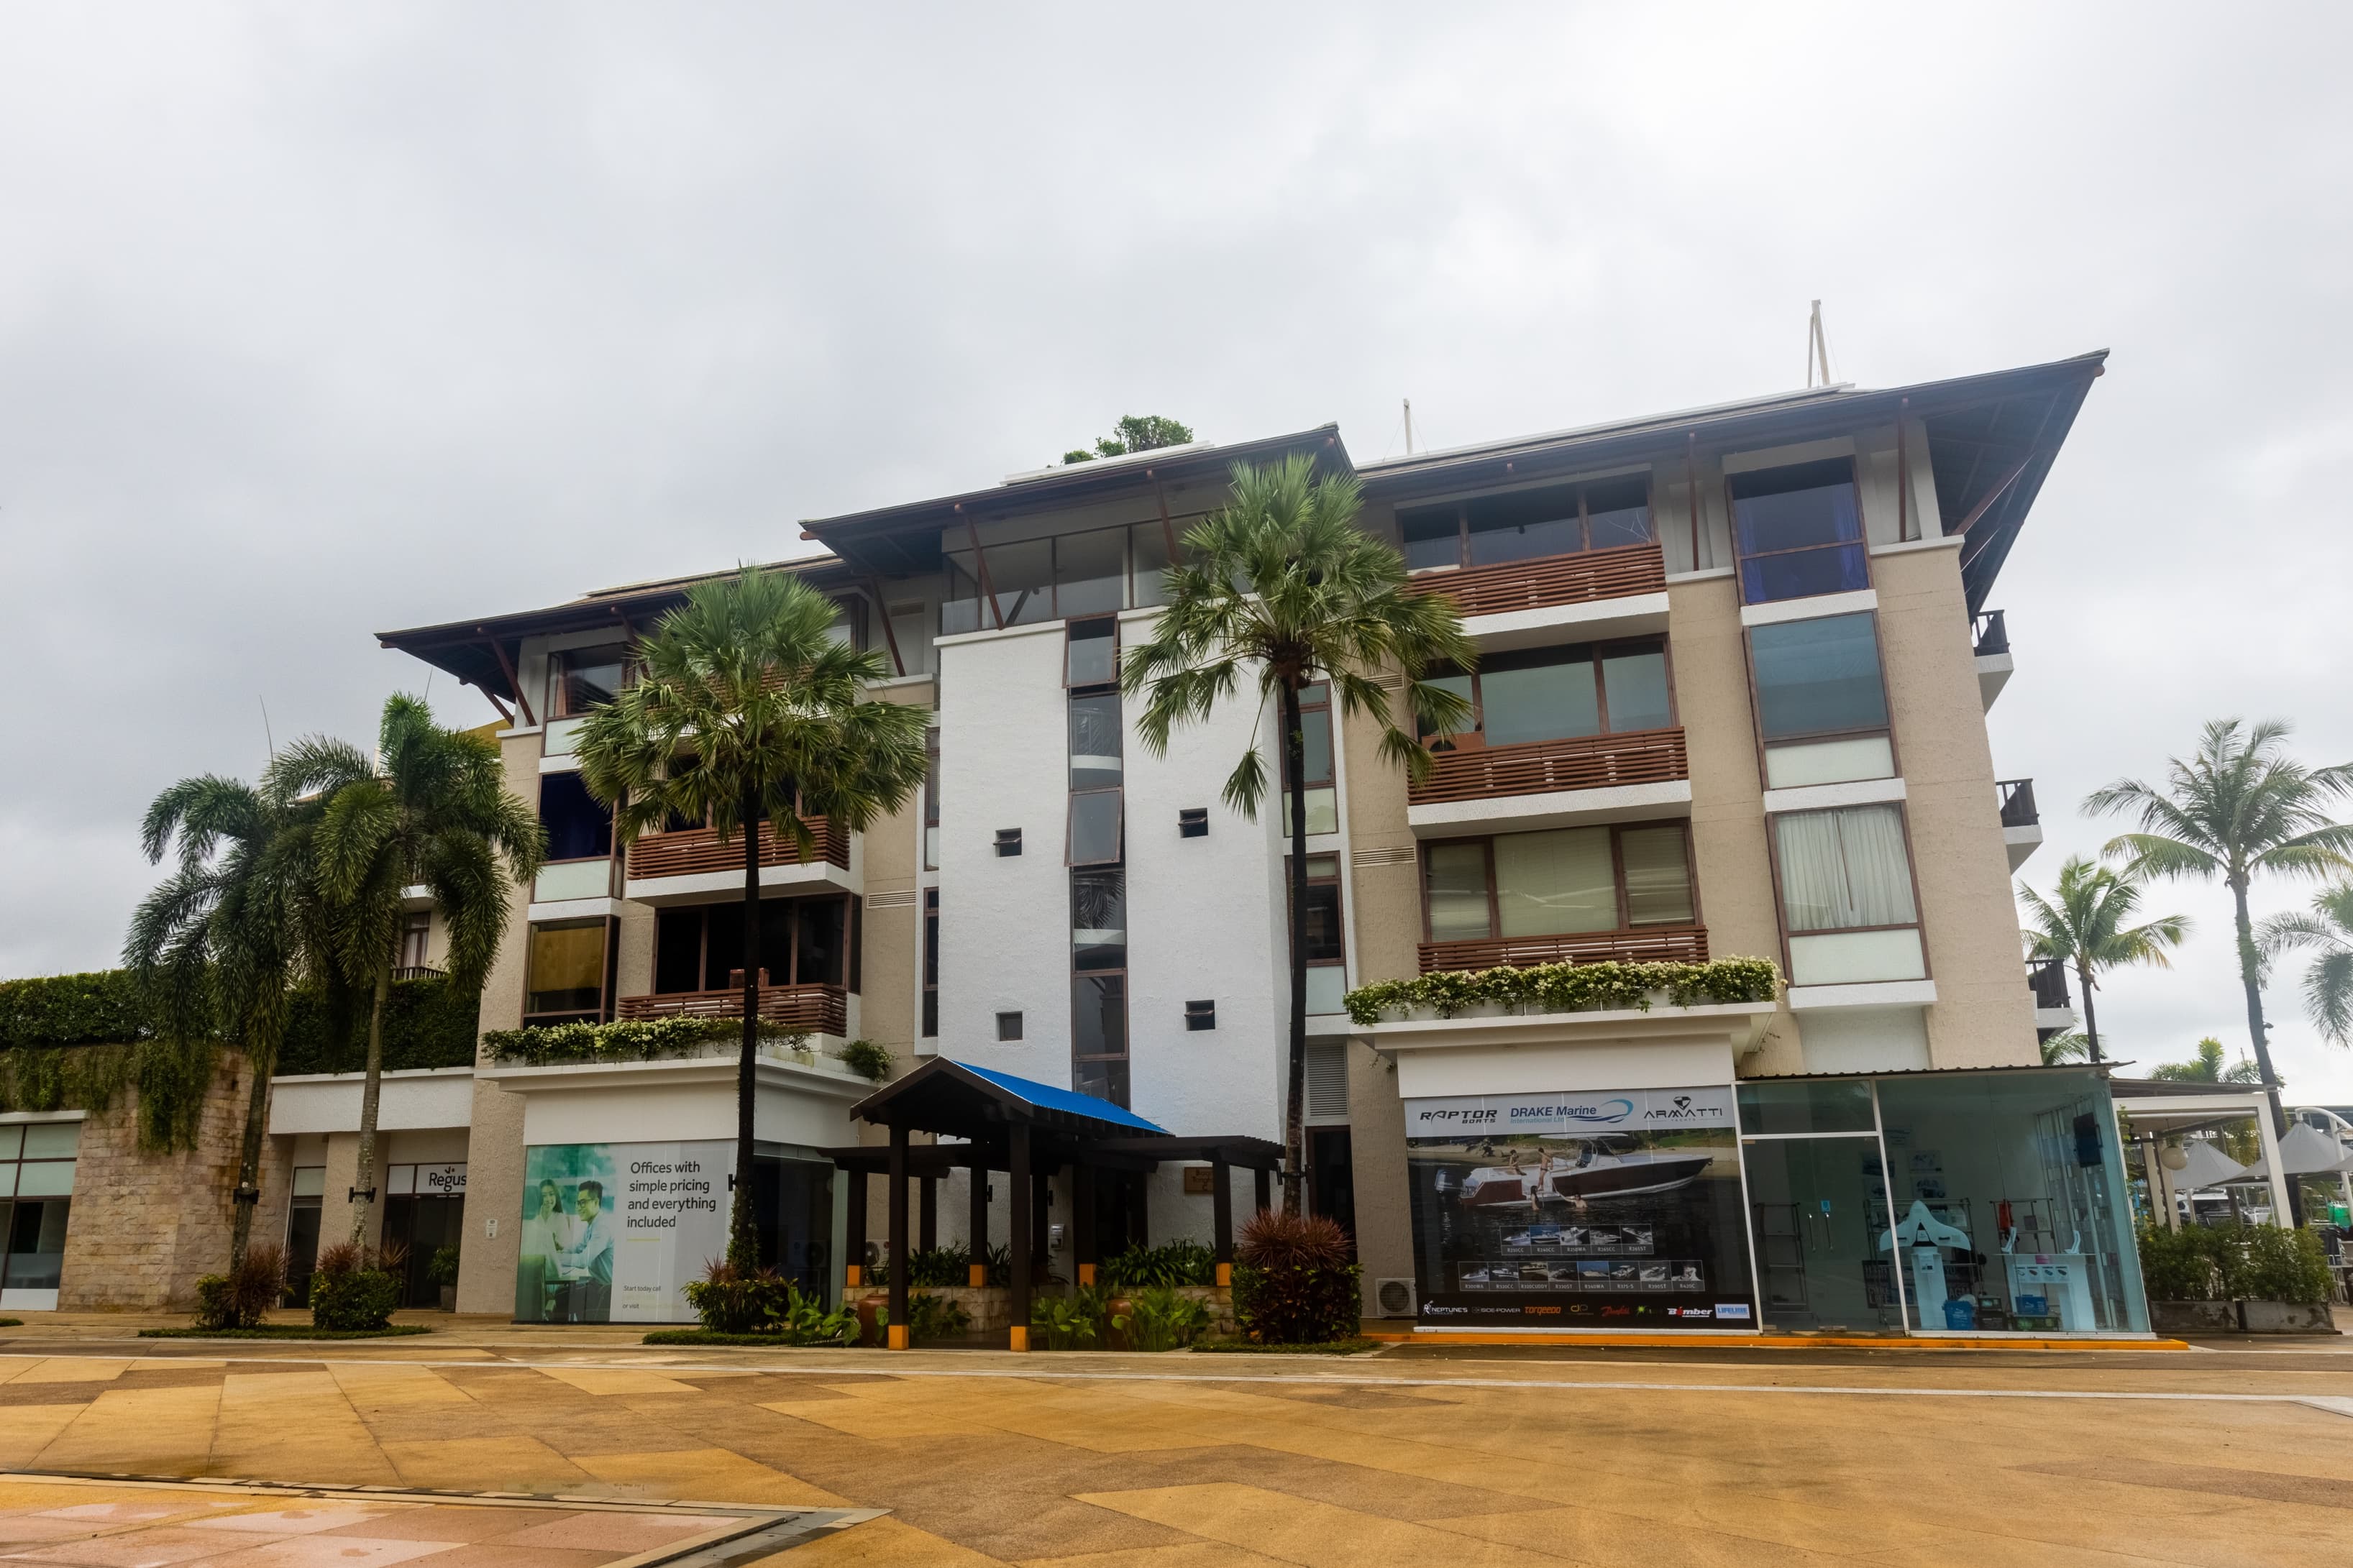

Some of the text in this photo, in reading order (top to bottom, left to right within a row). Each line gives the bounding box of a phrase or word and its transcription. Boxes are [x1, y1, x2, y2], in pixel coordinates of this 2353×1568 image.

[1420, 1109, 1497, 1124] RAPTOR
[1509, 1106, 1596, 1118] DRAKE Marine
[1644, 1108, 1723, 1119] ARMATTI
[631, 1160, 700, 1173] Offices with
[429, 1173, 467, 1192] Regus
[629, 1179, 710, 1195] simple pricing
[628, 1197, 717, 1213] and everything
[627, 1216, 677, 1228] included
[637, 1285, 652, 1293] today
